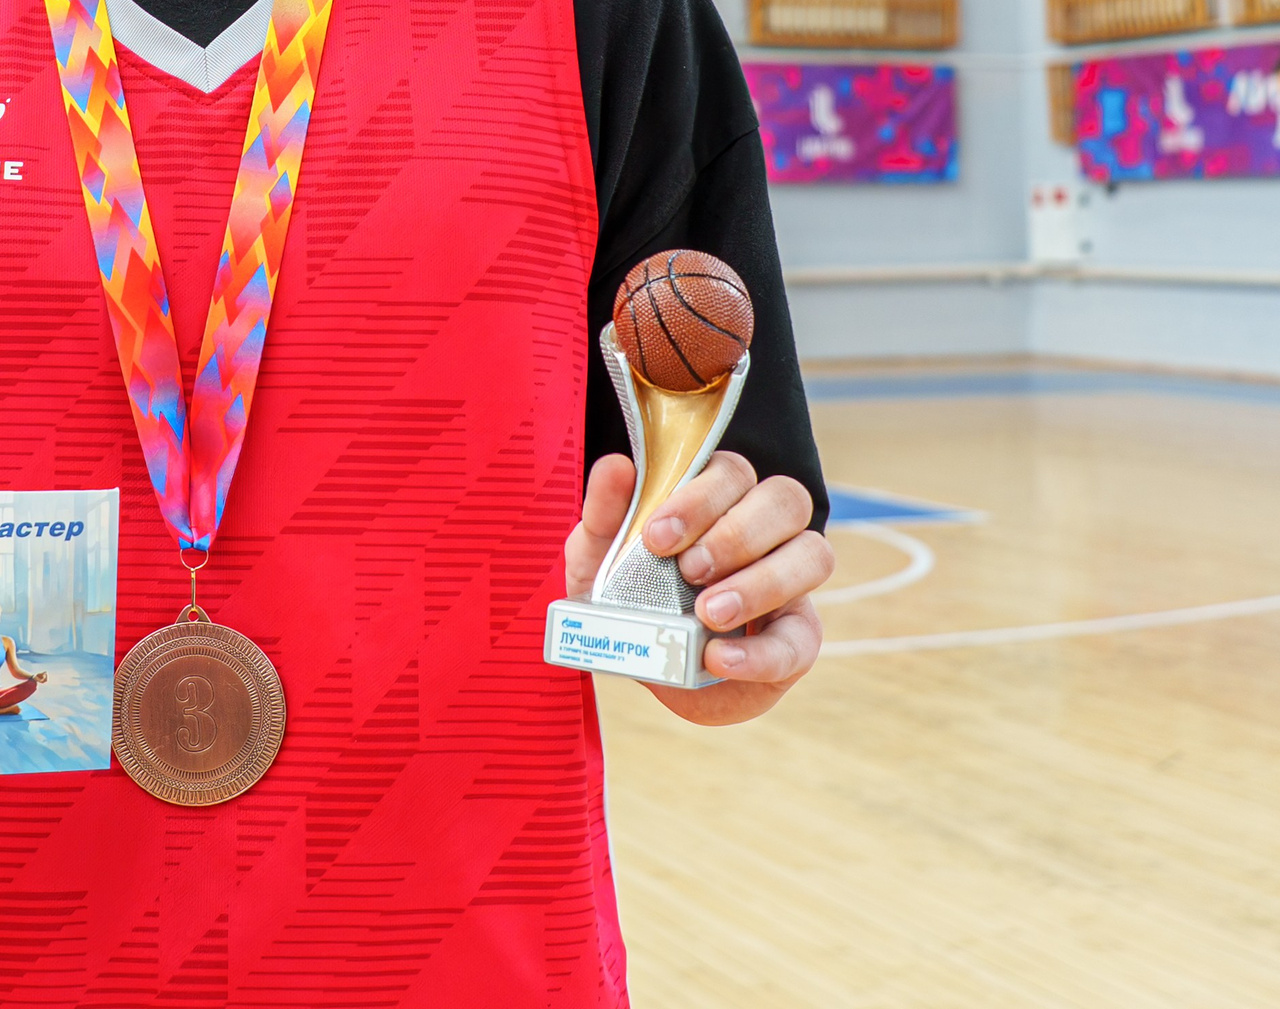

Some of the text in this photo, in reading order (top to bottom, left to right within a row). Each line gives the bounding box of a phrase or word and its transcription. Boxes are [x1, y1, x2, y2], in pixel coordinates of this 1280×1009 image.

[560, 631, 650, 658] ЛУЧШИЙ ИГРОК
[174, 674, 218, 754] 3
